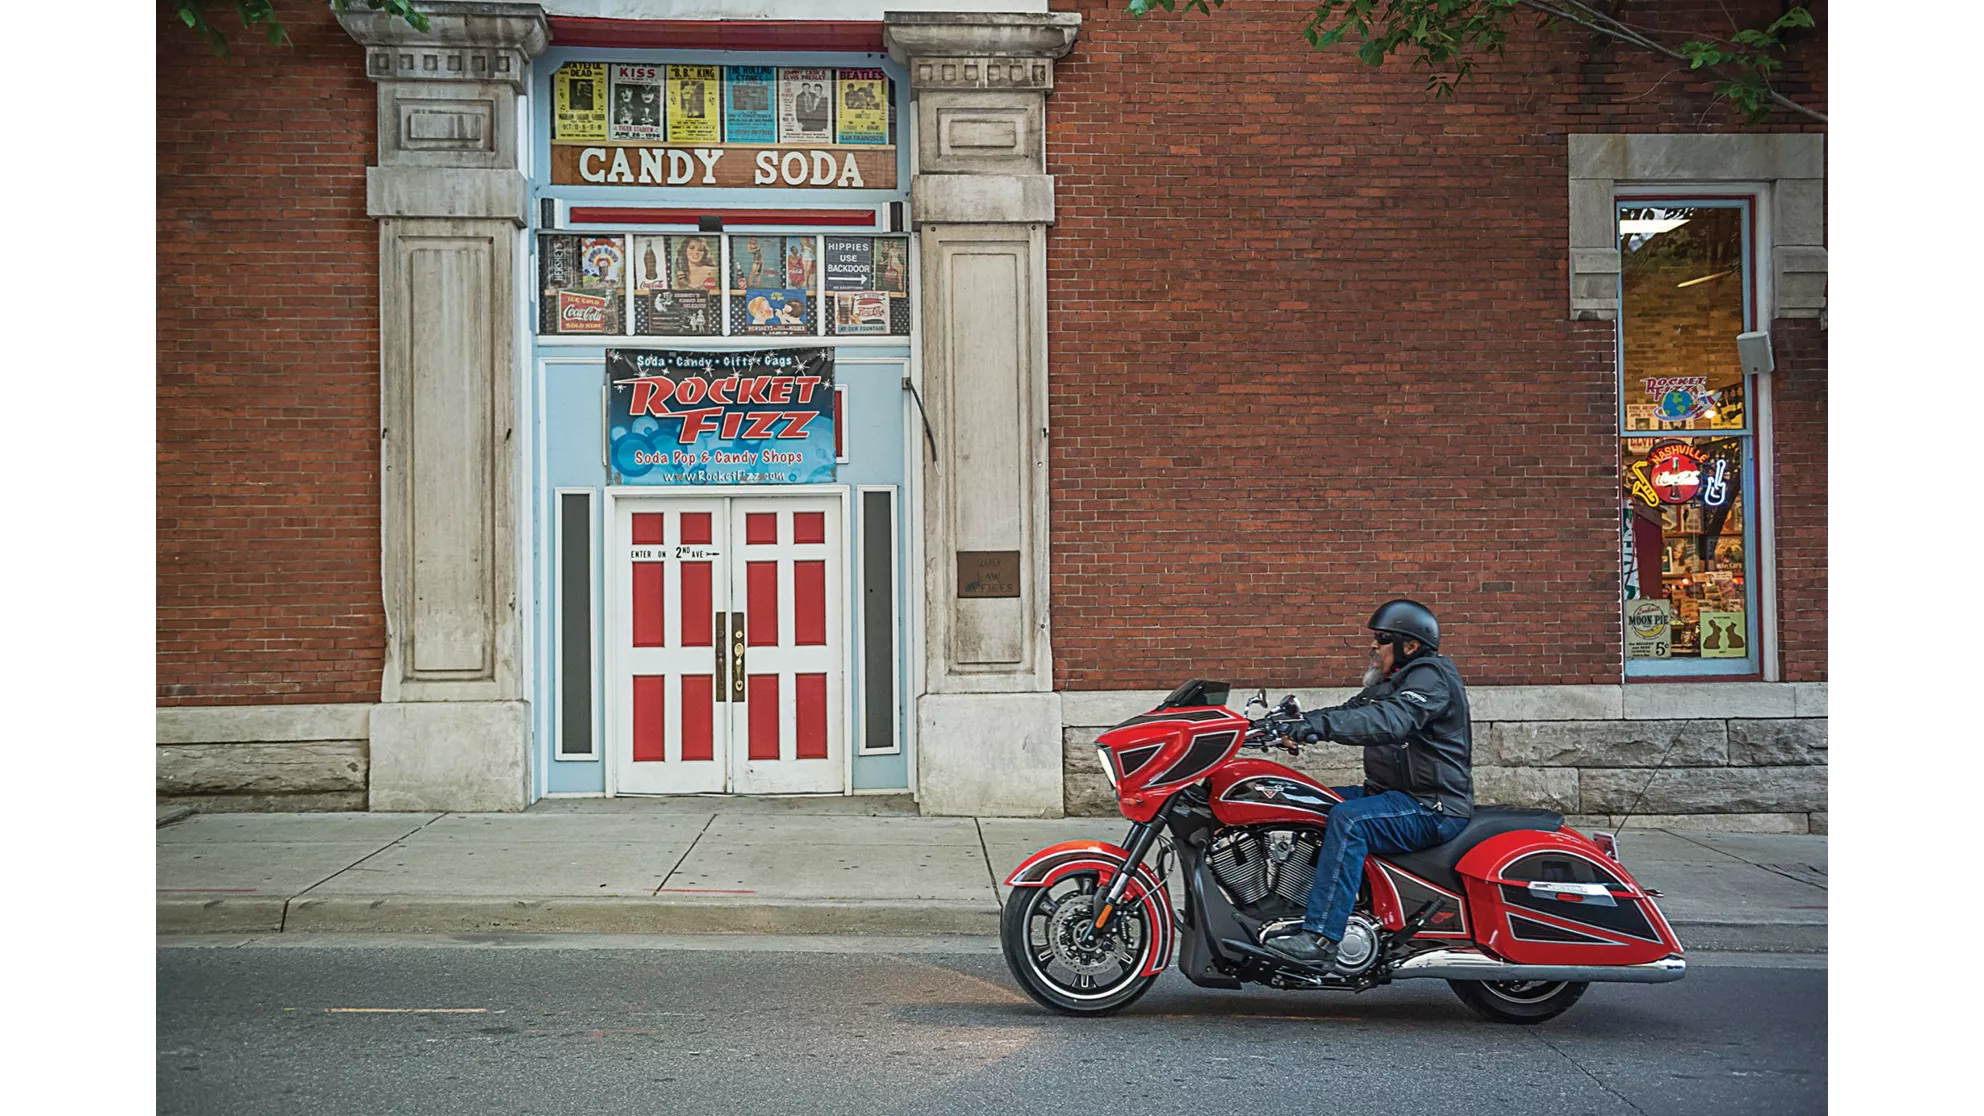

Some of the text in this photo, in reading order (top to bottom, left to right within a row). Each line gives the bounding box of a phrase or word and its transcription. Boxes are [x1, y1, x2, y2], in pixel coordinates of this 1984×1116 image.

[570, 69, 593, 77] DEAD
[620, 68, 656, 78] KISS
[697, 69, 715, 78] KING
[743, 66, 772, 75] ROLLING
[840, 71, 884, 80] BEATLES
[735, 74, 763, 84] STONES
[579, 148, 865, 187] CANDY SODA
[828, 243, 869, 251] HIPPIES
[827, 264, 870, 273] BACKDOOR
[636, 354, 792, 369] Soda Candy Gifts Gags
[1640, 376, 1707, 395] ROCKET
[613, 375, 821, 416] ROCKET
[1653, 385, 1694, 402] FIZZ
[655, 406, 820, 444] FIZZ
[635, 449, 803, 466] Soda Pop & Candy Shops
[1652, 444, 1709, 464] NASHVILLE
[631, 546, 703, 559] ENTER ON 2ND AVE
[978, 557, 1001, 567] 200
[1628, 615, 1669, 626] MOON PIE
